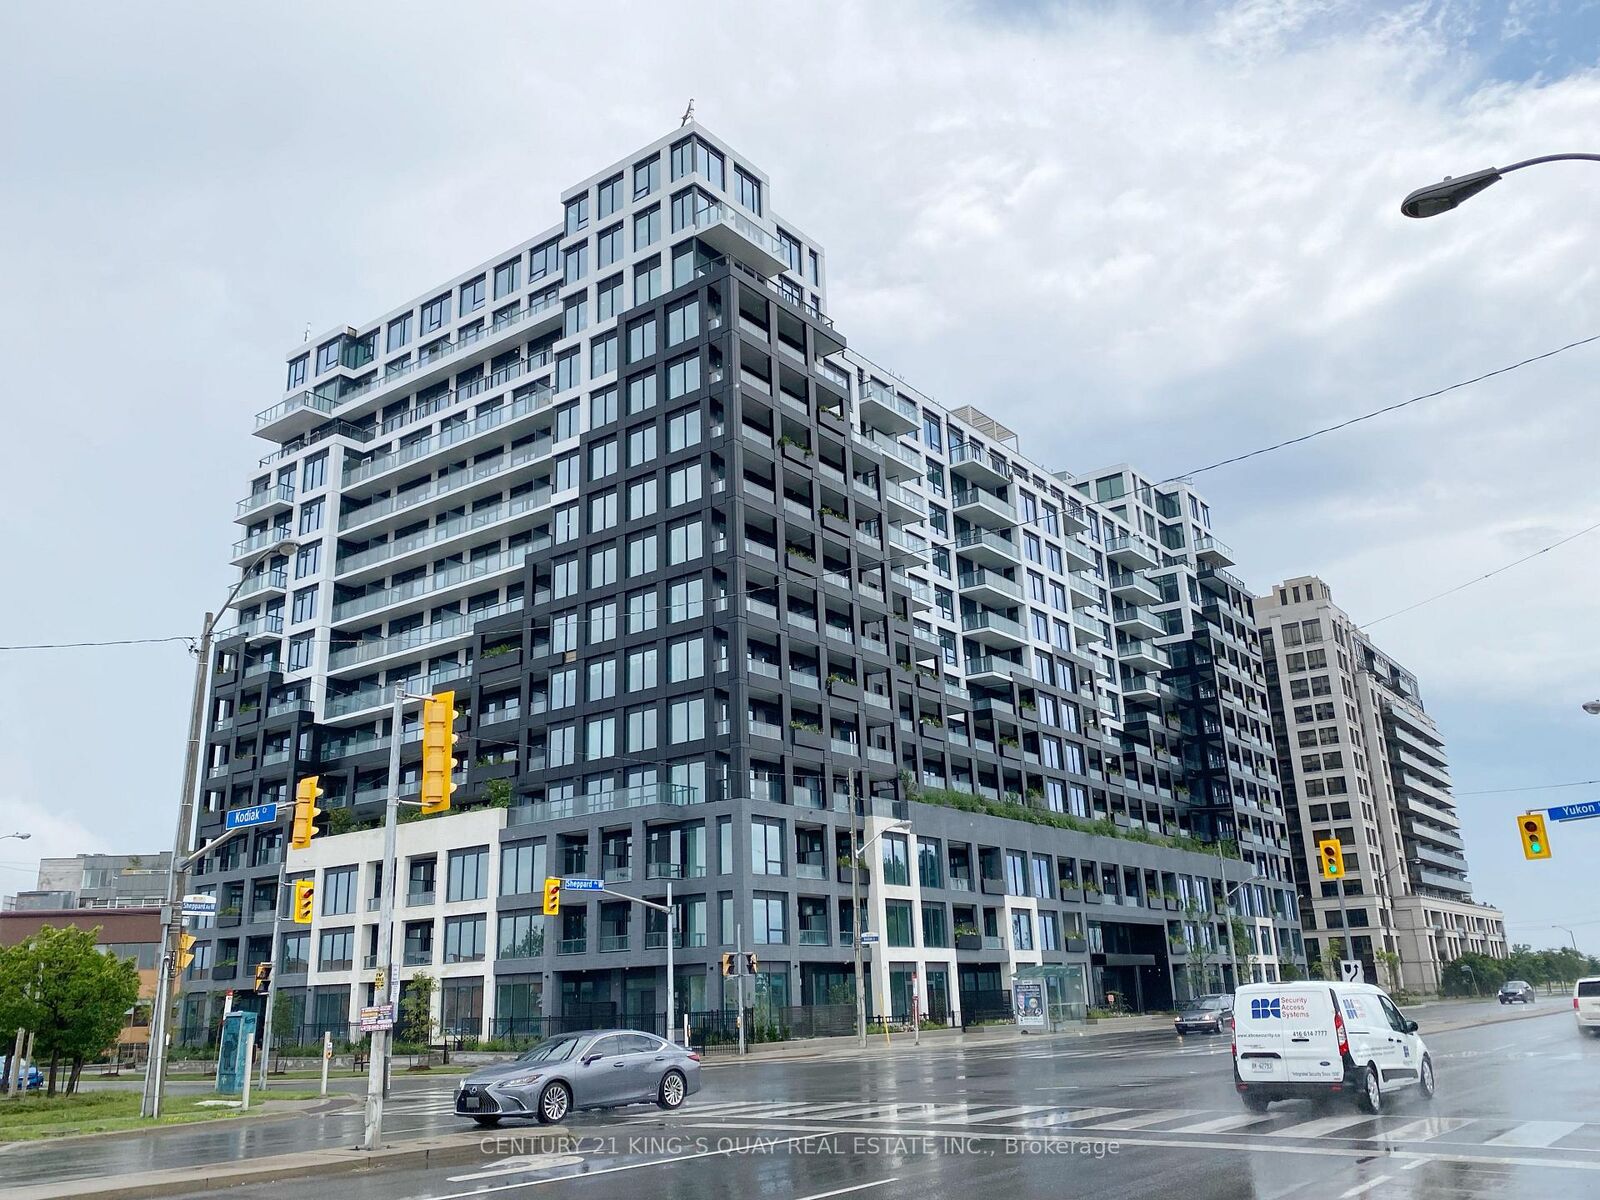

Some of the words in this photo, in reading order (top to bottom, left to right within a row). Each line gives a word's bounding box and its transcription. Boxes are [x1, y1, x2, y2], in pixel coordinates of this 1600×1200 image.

[1562, 804, 1596, 816] Yukon
[235, 809, 260, 823] Kodiak
[566, 880, 592, 888] Sheppard
[1281, 997, 1307, 1005] Security
